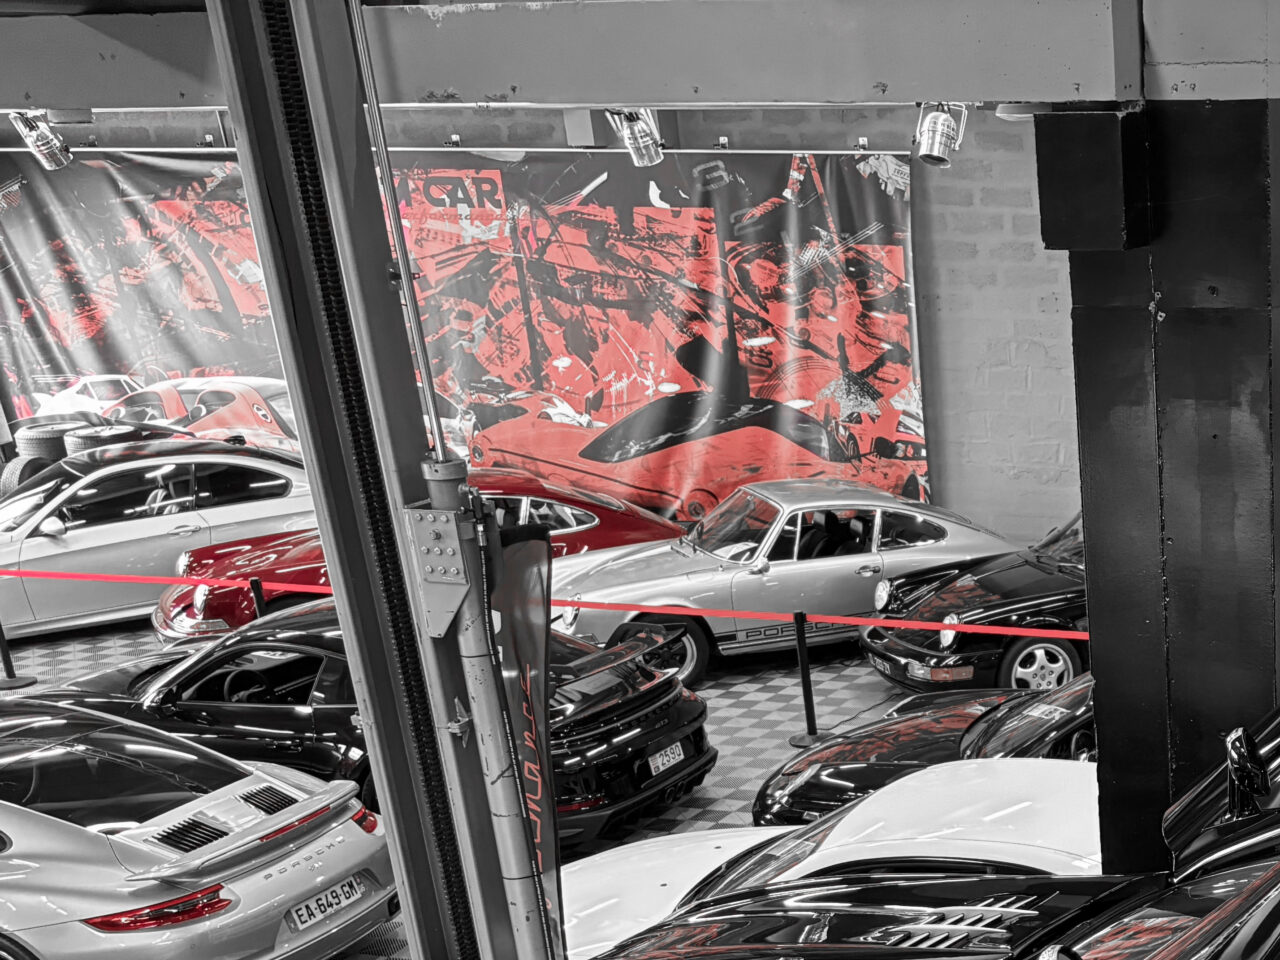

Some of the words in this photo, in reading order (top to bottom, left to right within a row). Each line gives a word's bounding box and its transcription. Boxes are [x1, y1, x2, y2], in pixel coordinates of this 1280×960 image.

[423, 176, 502, 209] CAR
[659, 744, 682, 766] 2590
[295, 879, 359, 925] EA-649-GM
